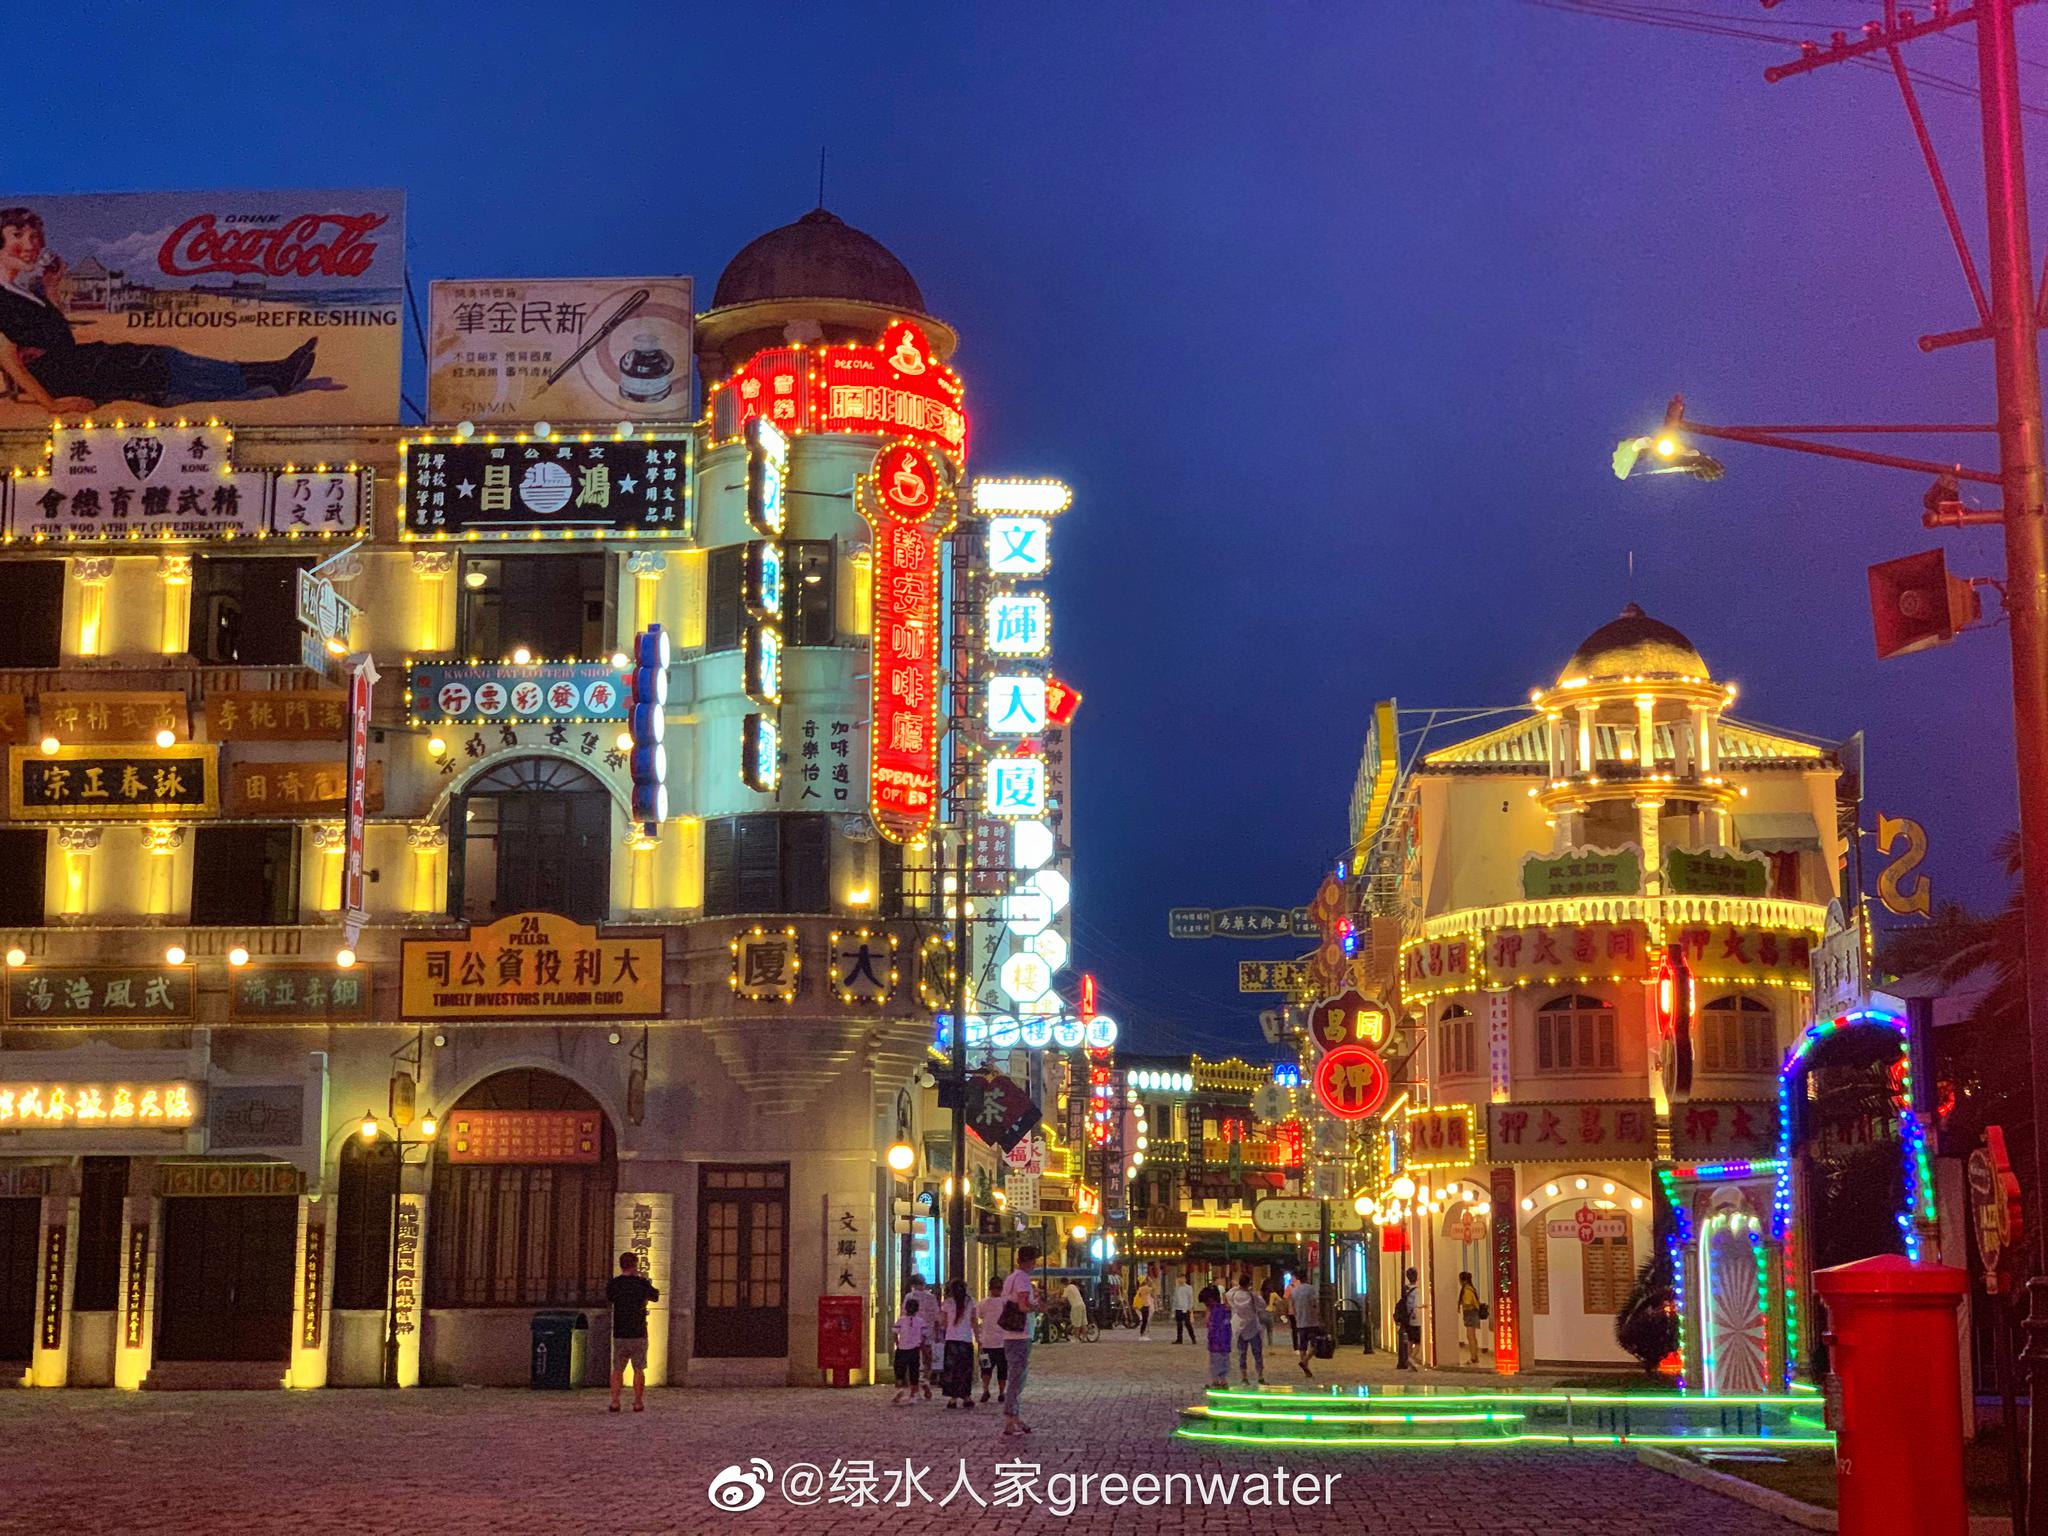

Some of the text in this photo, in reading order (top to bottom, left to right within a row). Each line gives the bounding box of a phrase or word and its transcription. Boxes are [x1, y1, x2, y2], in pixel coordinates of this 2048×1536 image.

[225, 214, 281, 224] DRINK
[126, 310, 398, 328] DELICIOUS AND REFRESHING
[69, 464, 210, 476] HONG KONG
[661, 449, 677, 523] 中西文具
[579, 667, 614, 678] SHOP
[996, 525, 1037, 807] 文輝大廈
[801, 719, 822, 800] 音樂怡人
[878, 767, 933, 789] SPECIAL
[520, 916, 541, 933] 24
[433, 992, 475, 1007] TIMELY
[475, 992, 541, 1007] INVESTORS
[836, 1211, 859, 1288] 文輝大
